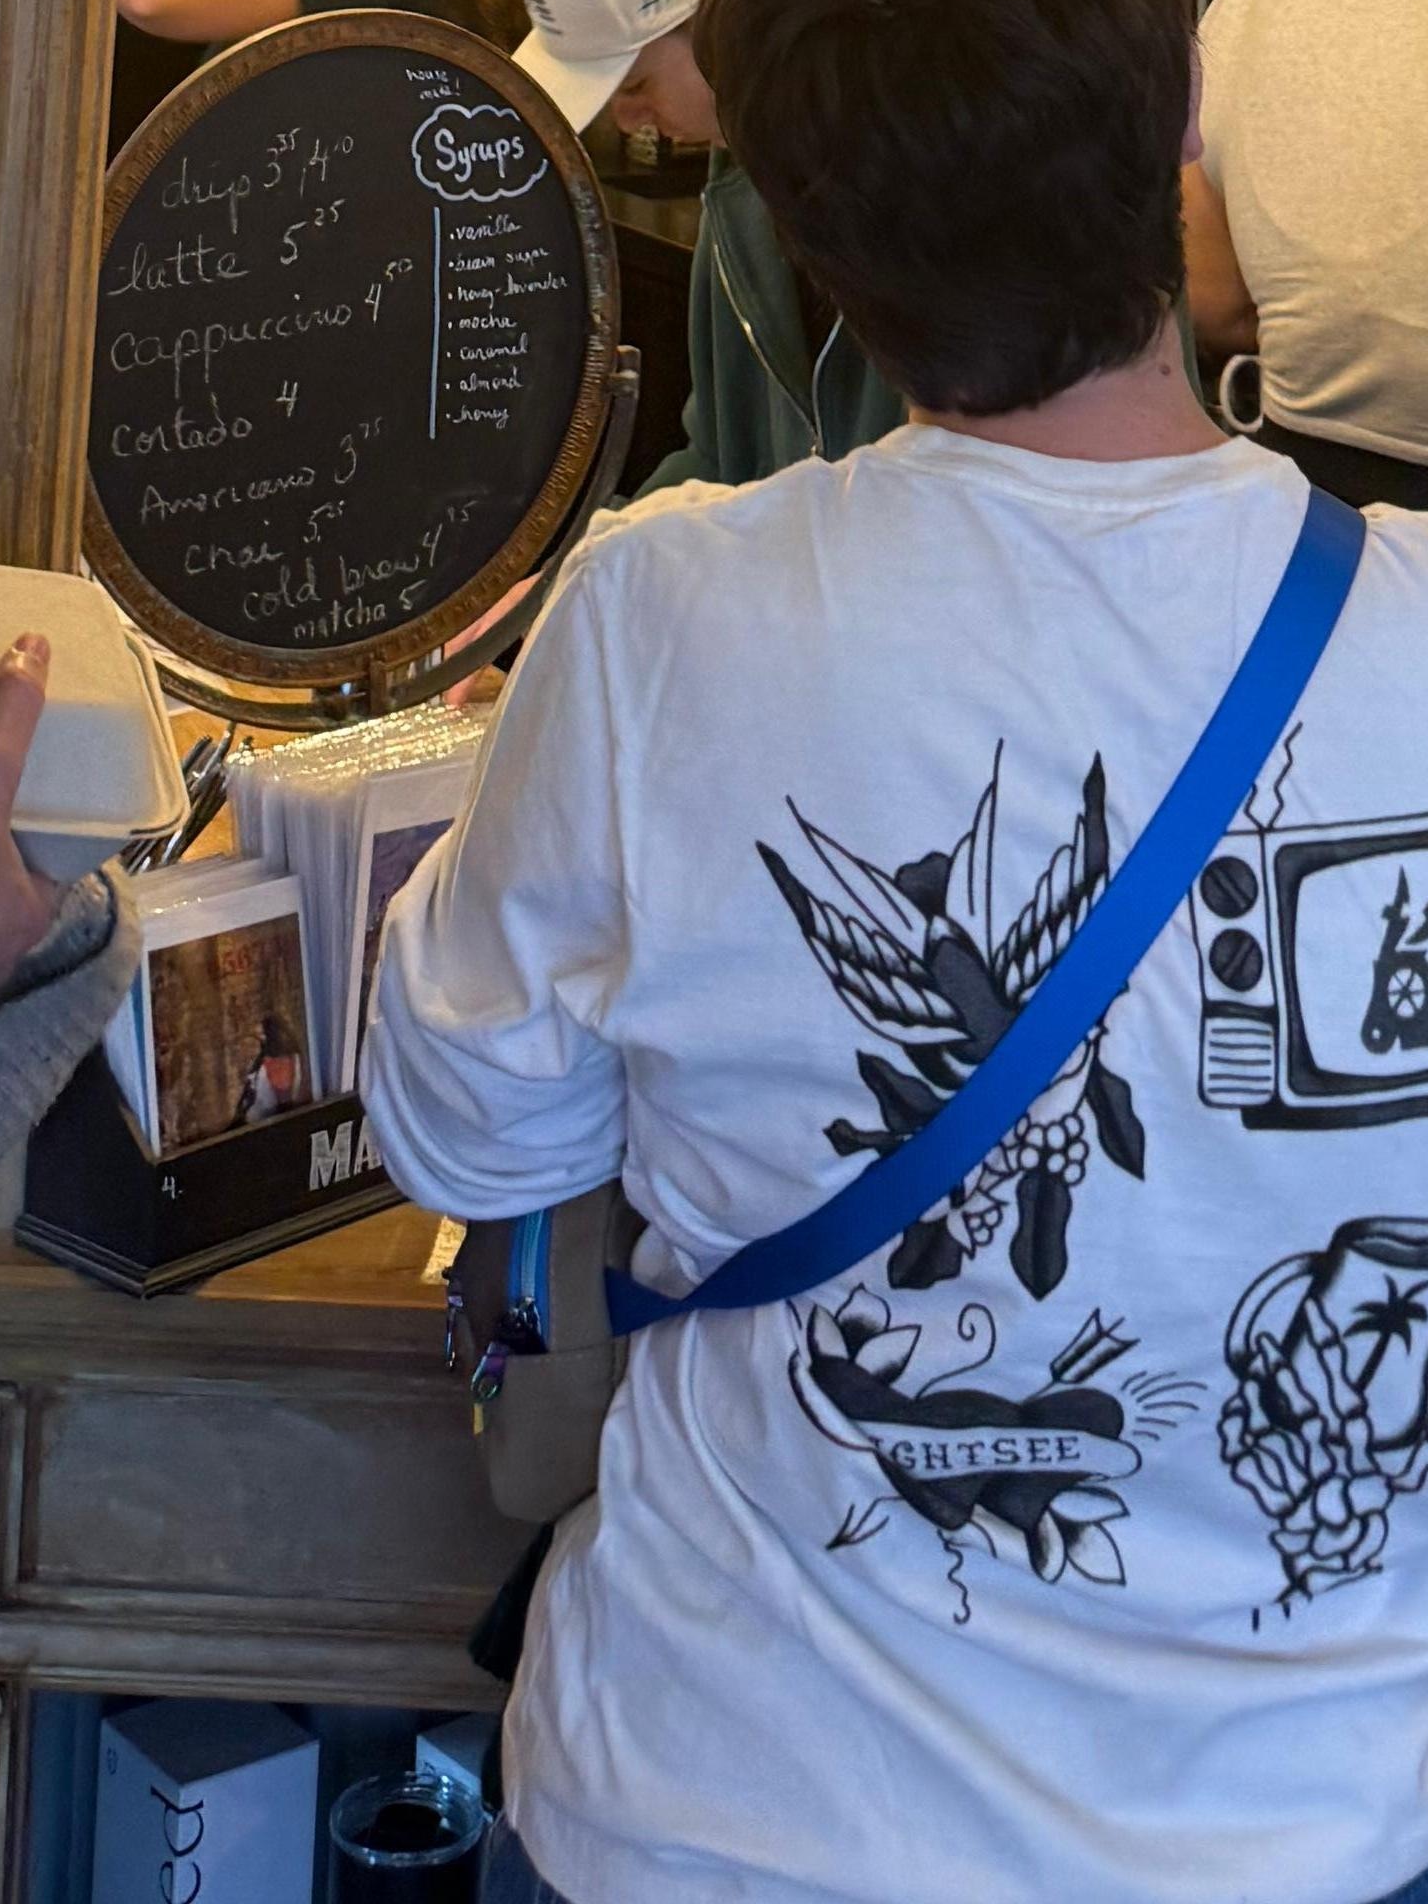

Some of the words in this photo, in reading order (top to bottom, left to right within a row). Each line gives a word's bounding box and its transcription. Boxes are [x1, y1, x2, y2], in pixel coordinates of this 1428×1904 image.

[434, 127, 525, 183] Syrups
[161, 156, 251, 235] drip
[456, 213, 522, 242] vanilla
[107, 233, 252, 296] latte
[110, 292, 353, 400] cappuccino
[459, 312, 518, 330] mocha
[459, 331, 530, 361] caramel
[459, 364, 524, 393] almond
[111, 392, 254, 457] cortado
[275, 379, 299, 417] 4
[140, 466, 317, 525] Americano
[184, 518, 284, 575] chai
[243, 555, 322, 622] cold
[338, 553, 420, 595] brew
[293, 598, 388, 641] matcha
[397, 579, 427, 612] 5
